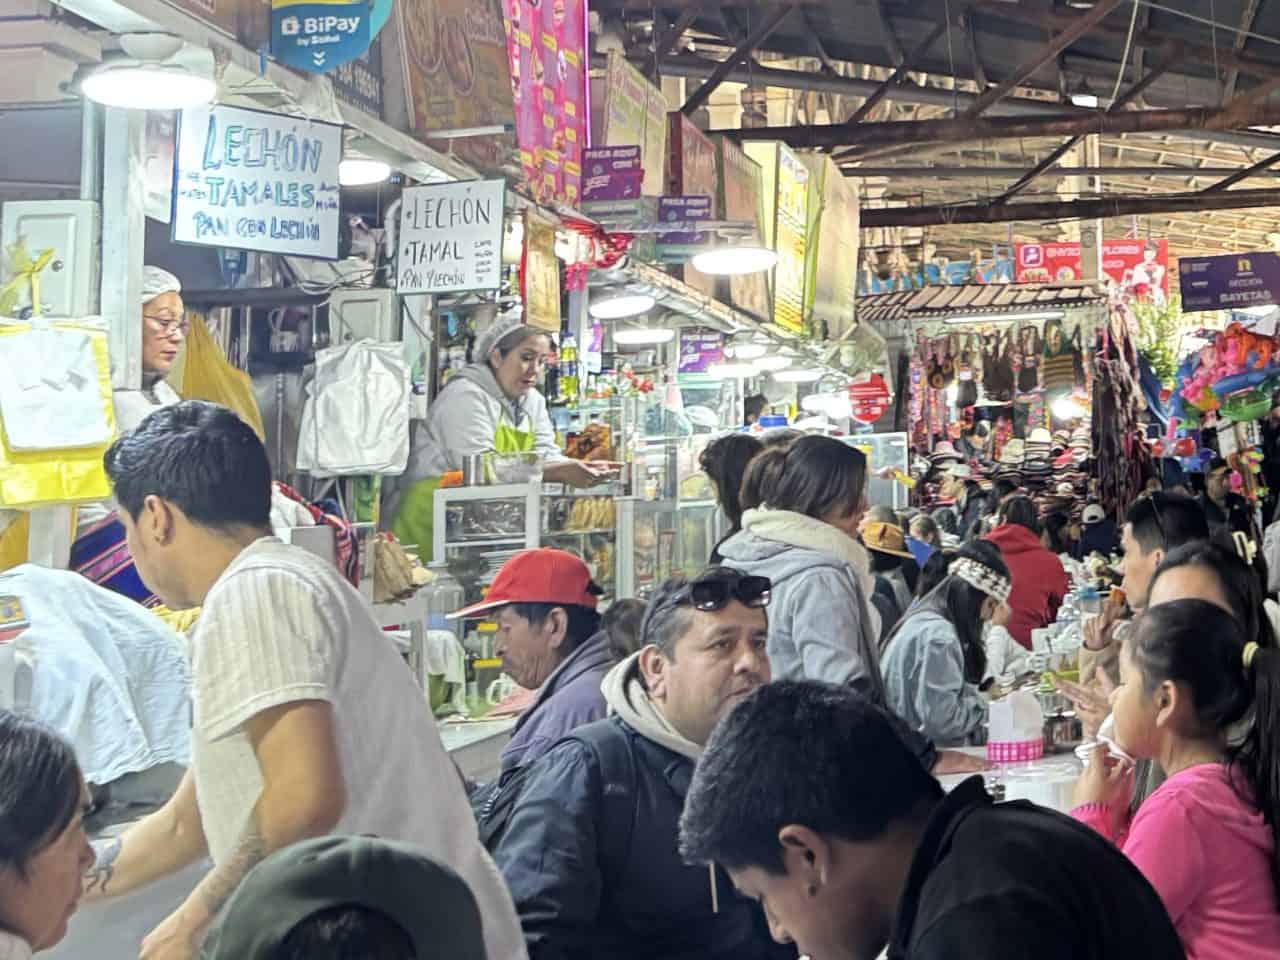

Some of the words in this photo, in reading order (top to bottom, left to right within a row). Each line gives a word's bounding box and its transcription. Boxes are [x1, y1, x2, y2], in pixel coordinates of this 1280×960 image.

[304, 15, 361, 35] BiPay
[206, 177, 315, 209] TAMALES
[409, 240, 464, 266] TAMAL
